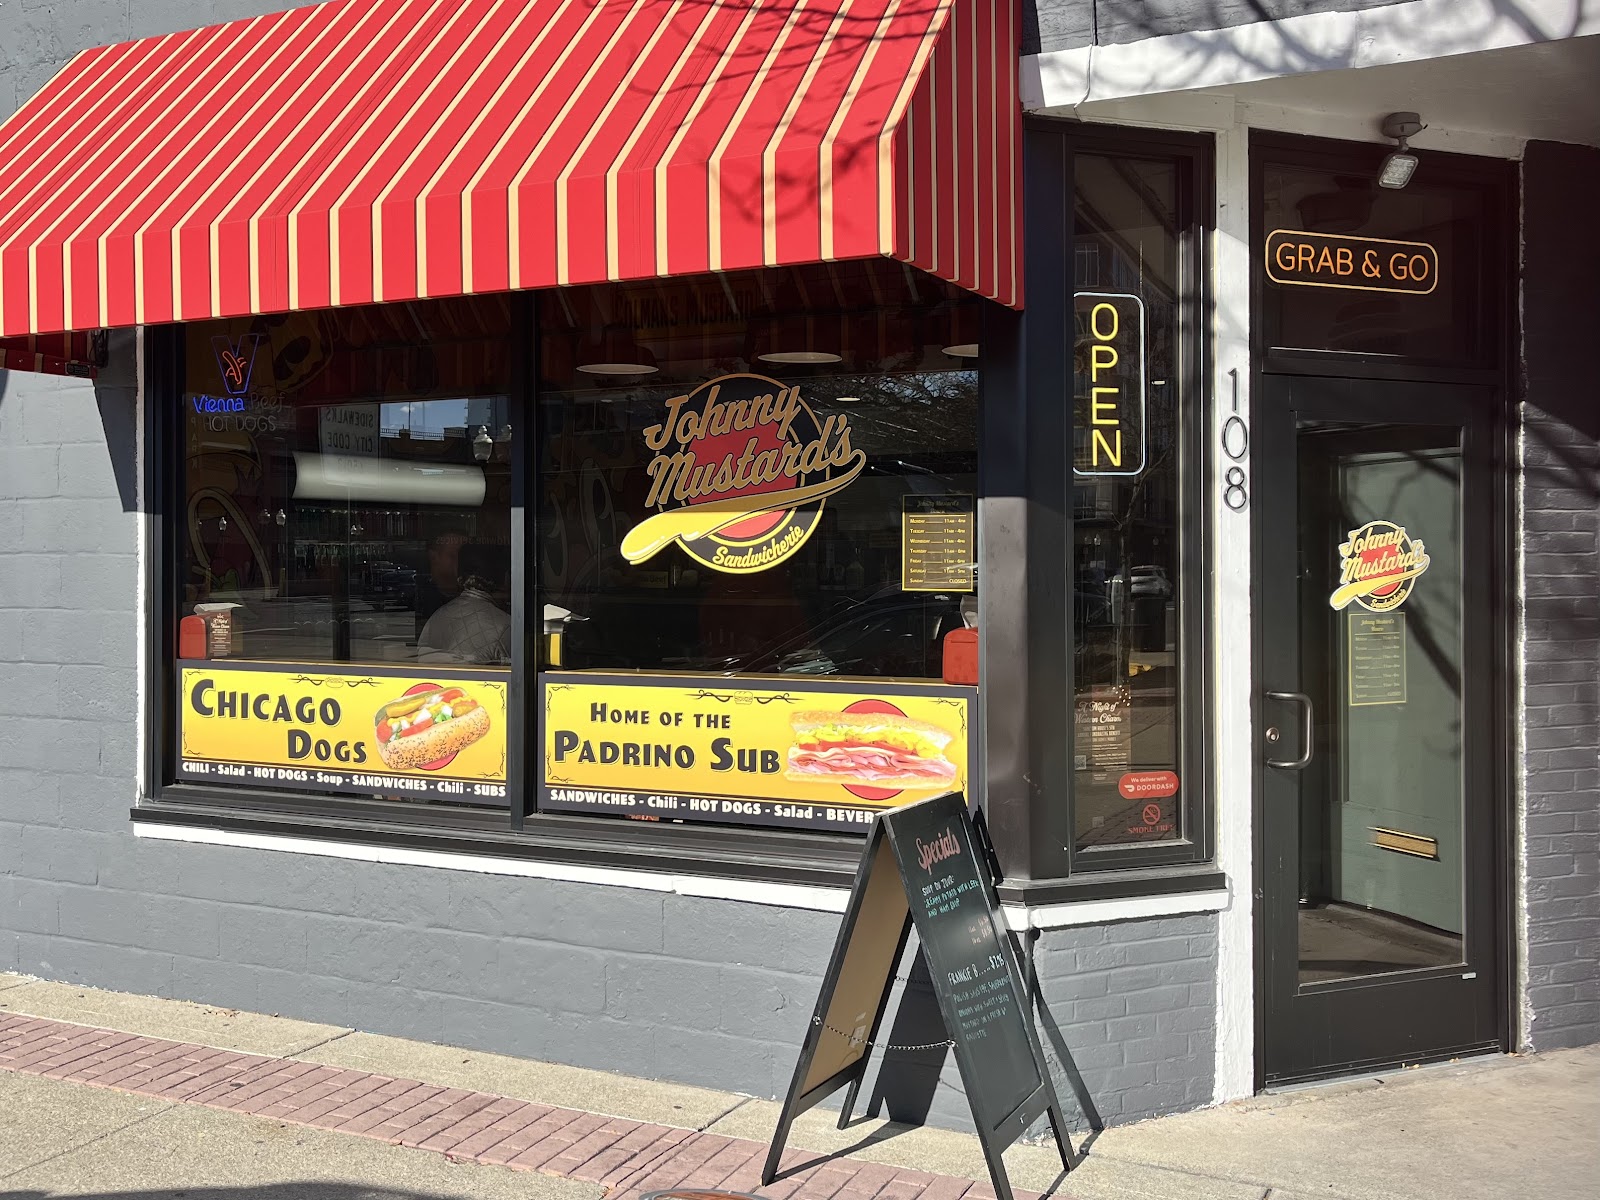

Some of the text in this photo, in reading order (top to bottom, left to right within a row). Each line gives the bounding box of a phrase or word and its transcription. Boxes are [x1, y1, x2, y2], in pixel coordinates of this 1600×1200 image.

[1275, 242, 1429, 282] GRAB & GO
[192, 391, 286, 414] Vienna Beef
[1091, 302, 1122, 467] OPEN
[202, 414, 278, 432] HOT DOGS
[643, 384, 802, 452] Johnny
[1221, 367, 1249, 510] 108
[645, 413, 853, 508] Mustard's
[711, 524, 805, 569] Sandwicherie
[1339, 527, 1405, 556] Johnny
[1342, 541, 1425, 582] Mustard's
[190, 678, 342, 727] CHICAGO
[590, 702, 731, 730] HOME OF THE
[287, 728, 368, 764] DOGS
[554, 729, 781, 775] PADRINO SUB
[182, 761, 210, 774] CHILI
[218, 764, 246, 776] Salad
[253, 766, 276, 779] HOT
[278, 769, 308, 782] DOGS
[316, 772, 344, 786] Soup
[352, 774, 427, 791] SANDWICHES
[437, 781, 464, 794] Chili
[474, 784, 506, 798] SUBS
[1136, 783, 1174, 792] DOORDASH
[550, 789, 636, 806] SANDWICHES
[647, 795, 678, 809] Chili
[689, 798, 719, 812] HOT
[722, 800, 761, 816] DOGS
[774, 804, 813, 820] Salad
[826, 808, 874, 824] BEVER
[915, 826, 961, 875] Specials
[948, 966, 972, 986] FRANKIE
